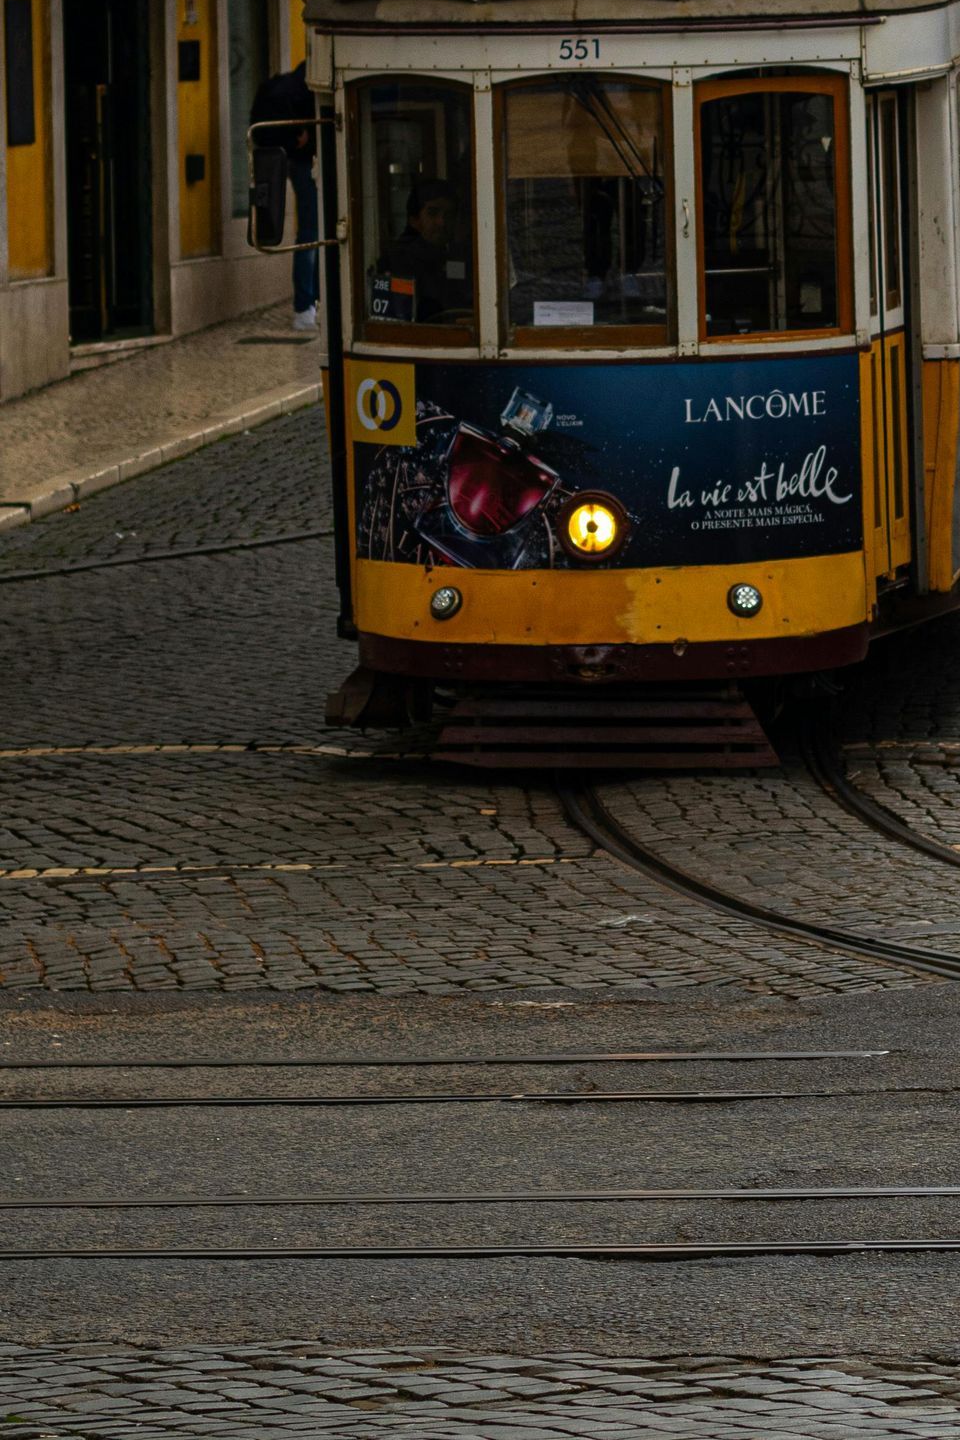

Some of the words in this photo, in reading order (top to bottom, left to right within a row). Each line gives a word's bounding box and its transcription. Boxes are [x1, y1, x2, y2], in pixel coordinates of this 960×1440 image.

[560, 38, 599, 60] 551
[374, 279, 390, 292] 28E
[373, 298, 389, 314] 07
[684, 389, 826, 423] LANCÔME
[701, 480, 732, 506] vie
[737, 462, 775, 502] est
[776, 445, 852, 504] belle
[691, 521, 700, 530] O
[702, 518, 753, 530] PRESENTE
[755, 516, 780, 527] MAIS
[782, 513, 825, 525] ESPECIAL
[704, 510, 712, 520] A
[714, 509, 745, 519] NOITE
[747, 507, 773, 517] MAIS
